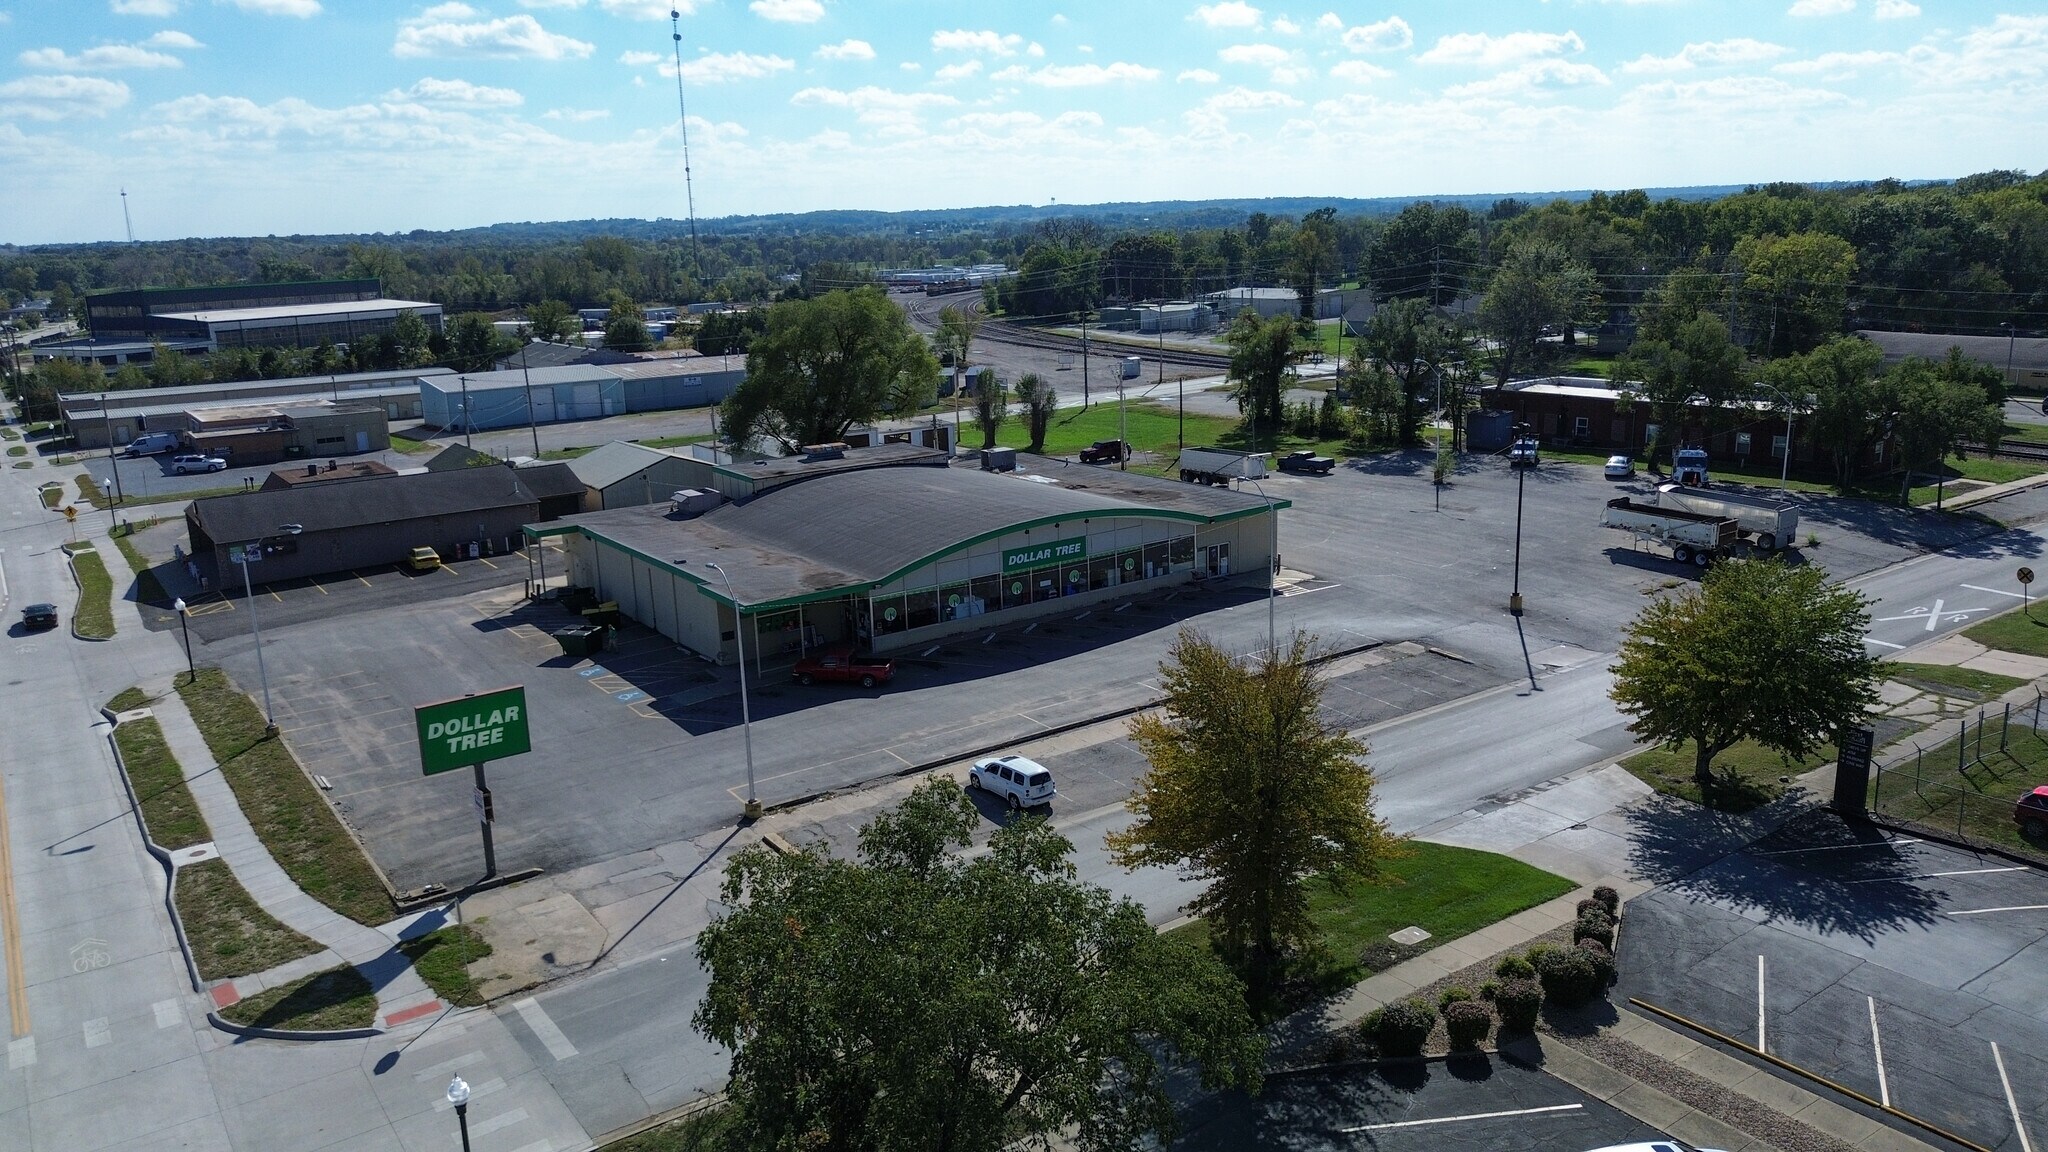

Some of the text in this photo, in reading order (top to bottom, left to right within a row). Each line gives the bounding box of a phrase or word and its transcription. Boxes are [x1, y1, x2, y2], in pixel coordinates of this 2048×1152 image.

[1008, 543, 1081, 565] DOLLAR TREE
[427, 705, 520, 740] DOLLAR
[446, 727, 504, 754] TREE
